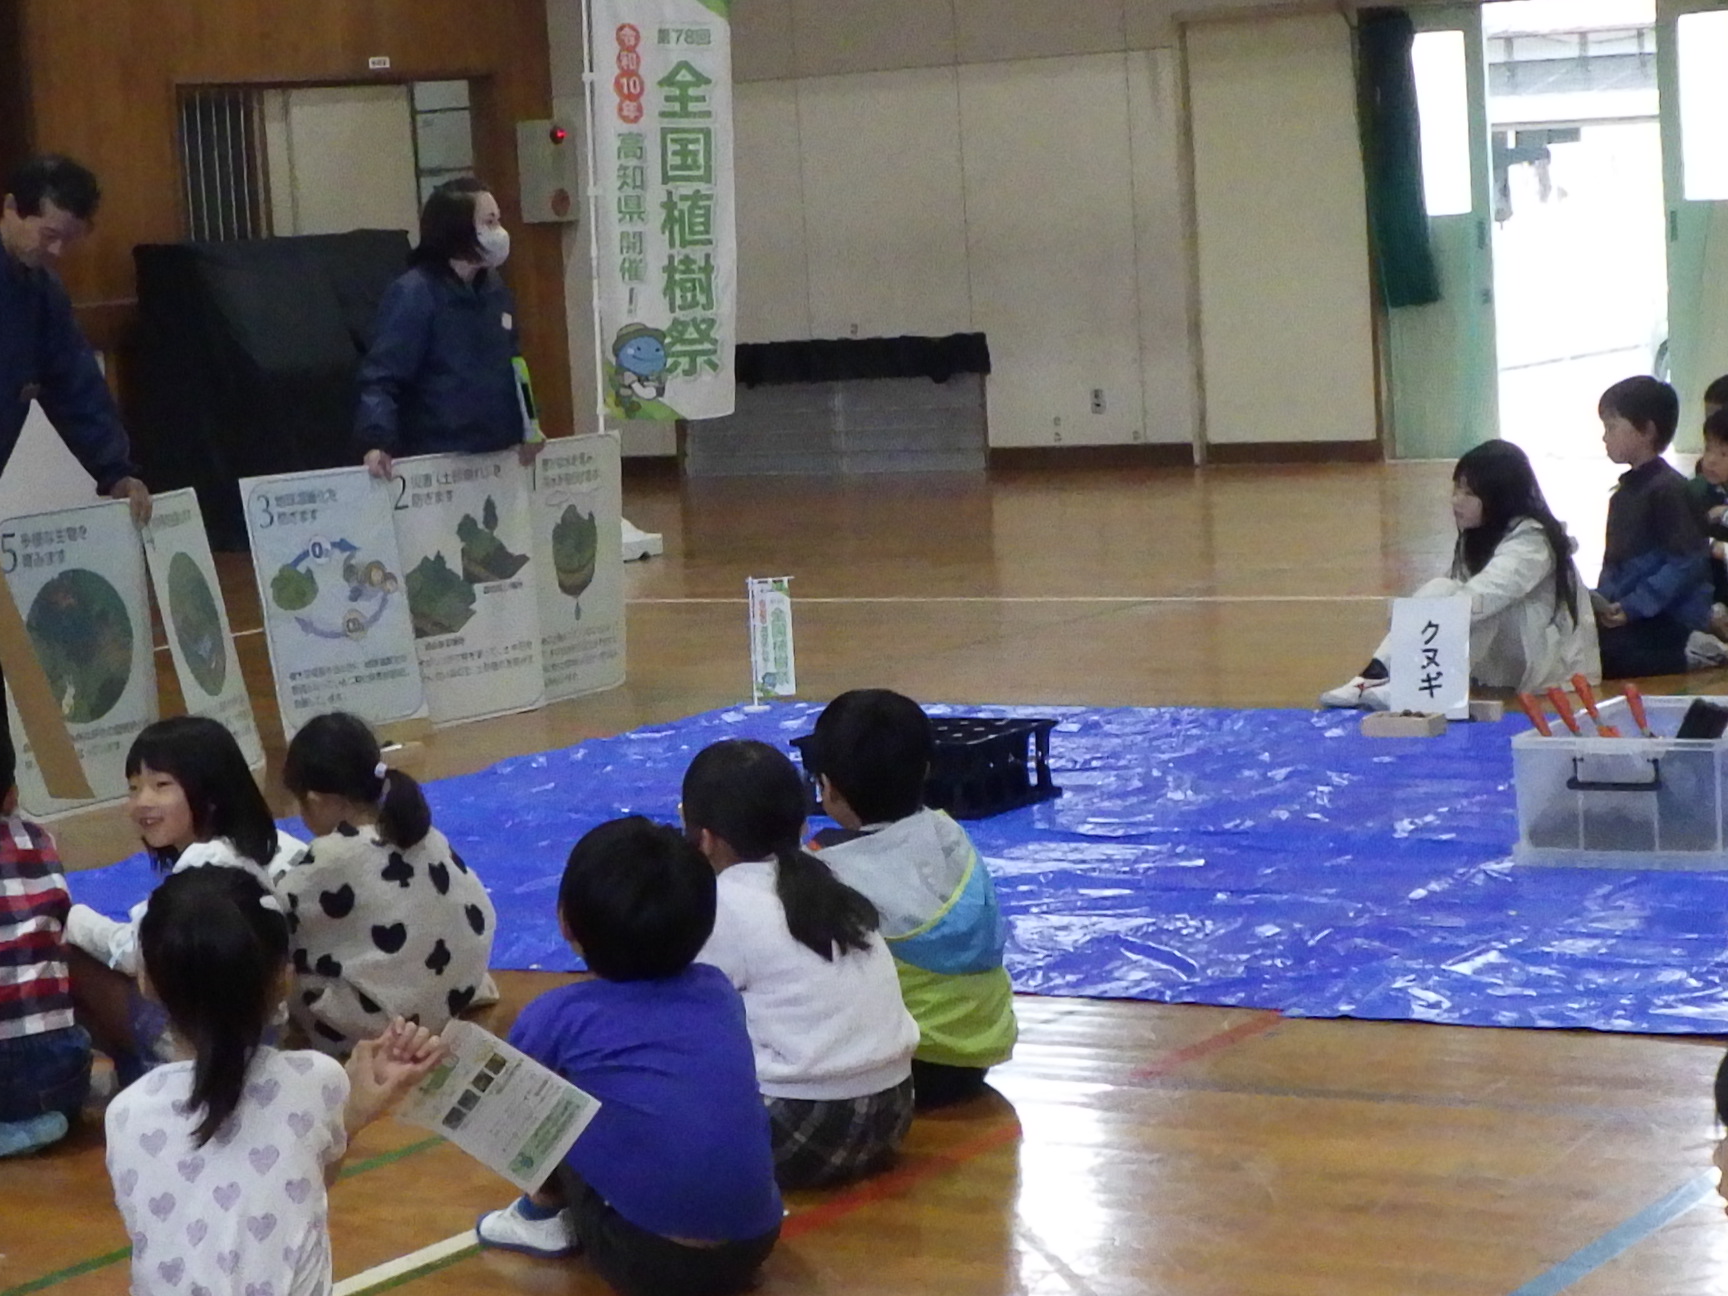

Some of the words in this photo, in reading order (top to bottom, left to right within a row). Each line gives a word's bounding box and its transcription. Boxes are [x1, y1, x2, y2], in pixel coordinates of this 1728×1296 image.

[656, 27, 712, 46] 第78回
[656, 59, 721, 380] 全国植樹祭
[1418, 618, 1444, 698] クヌギ
